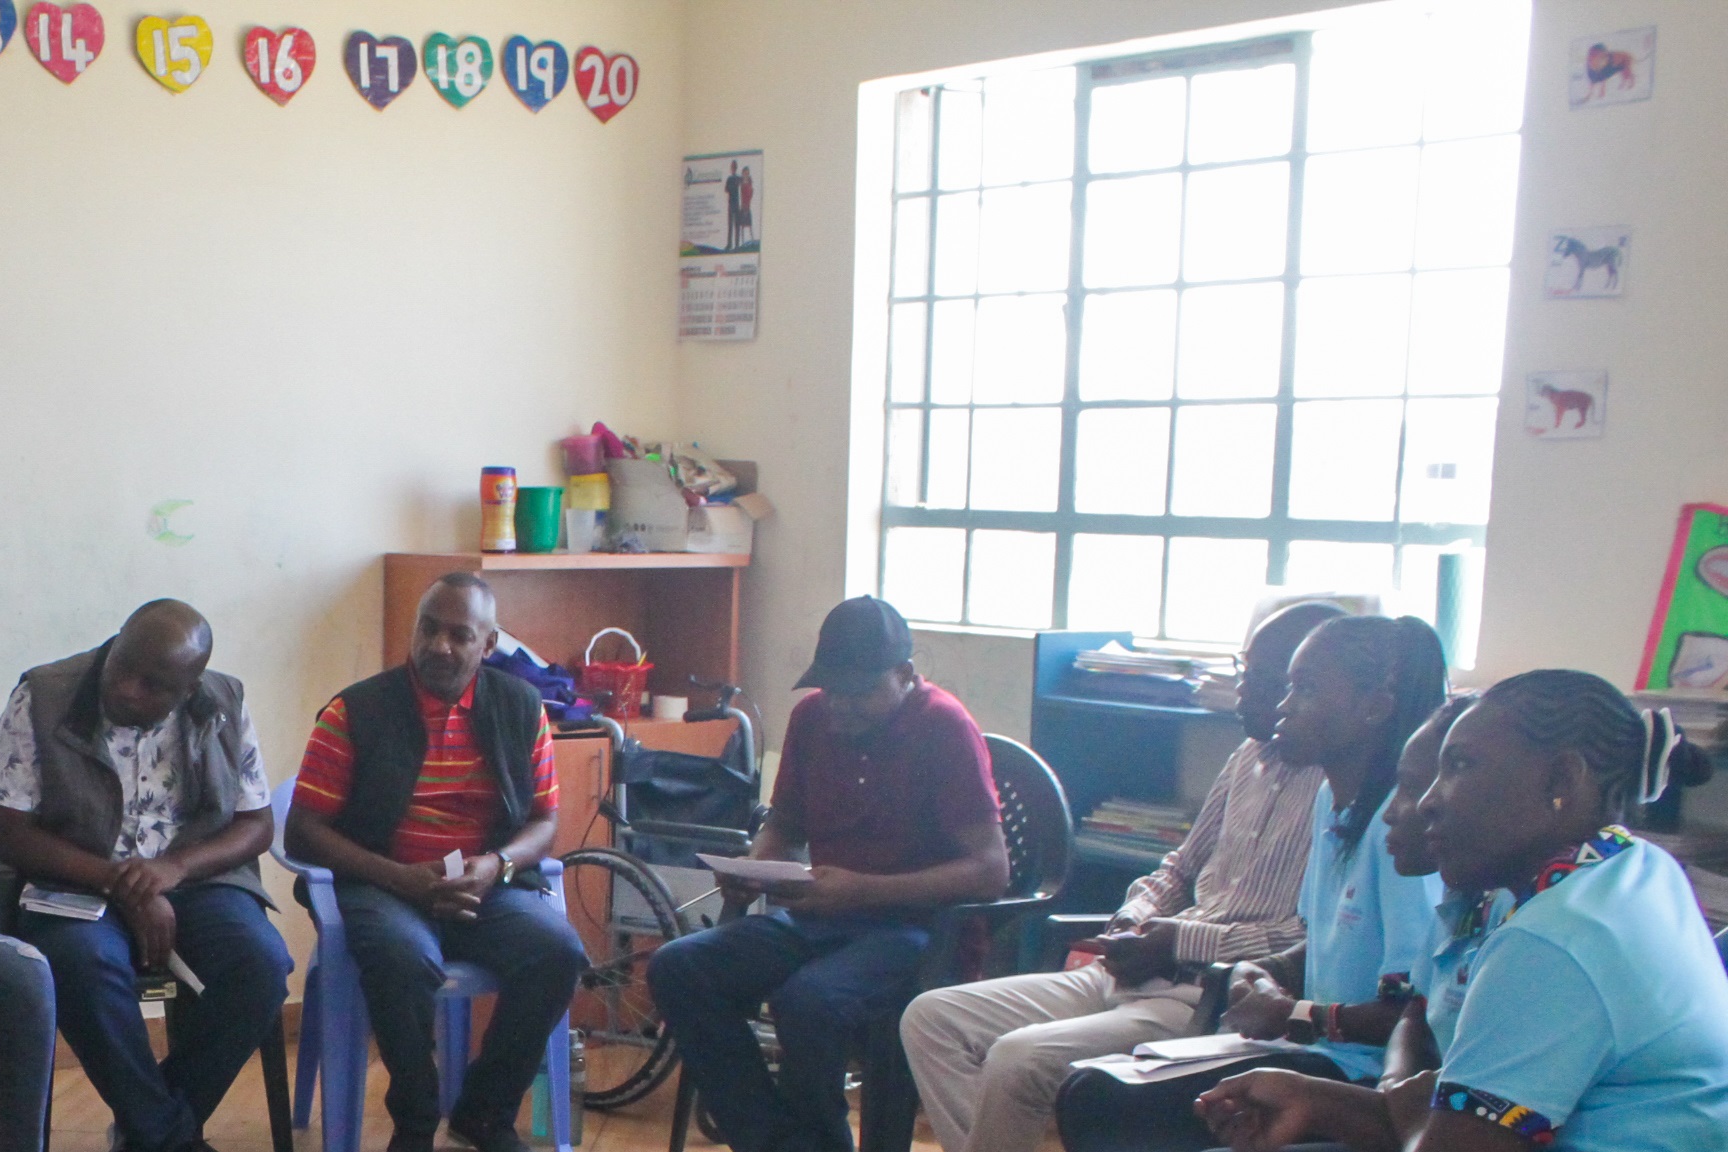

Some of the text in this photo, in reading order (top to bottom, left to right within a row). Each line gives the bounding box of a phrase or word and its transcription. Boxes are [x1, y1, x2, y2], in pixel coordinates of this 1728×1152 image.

[38, 13, 94, 71] 14
[152, 25, 202, 86] 15
[257, 33, 302, 93] 16
[359, 42, 400, 93] 17
[437, 43, 483, 97] 18
[516, 46, 555, 99] 19
[580, 56, 633, 108] 20
